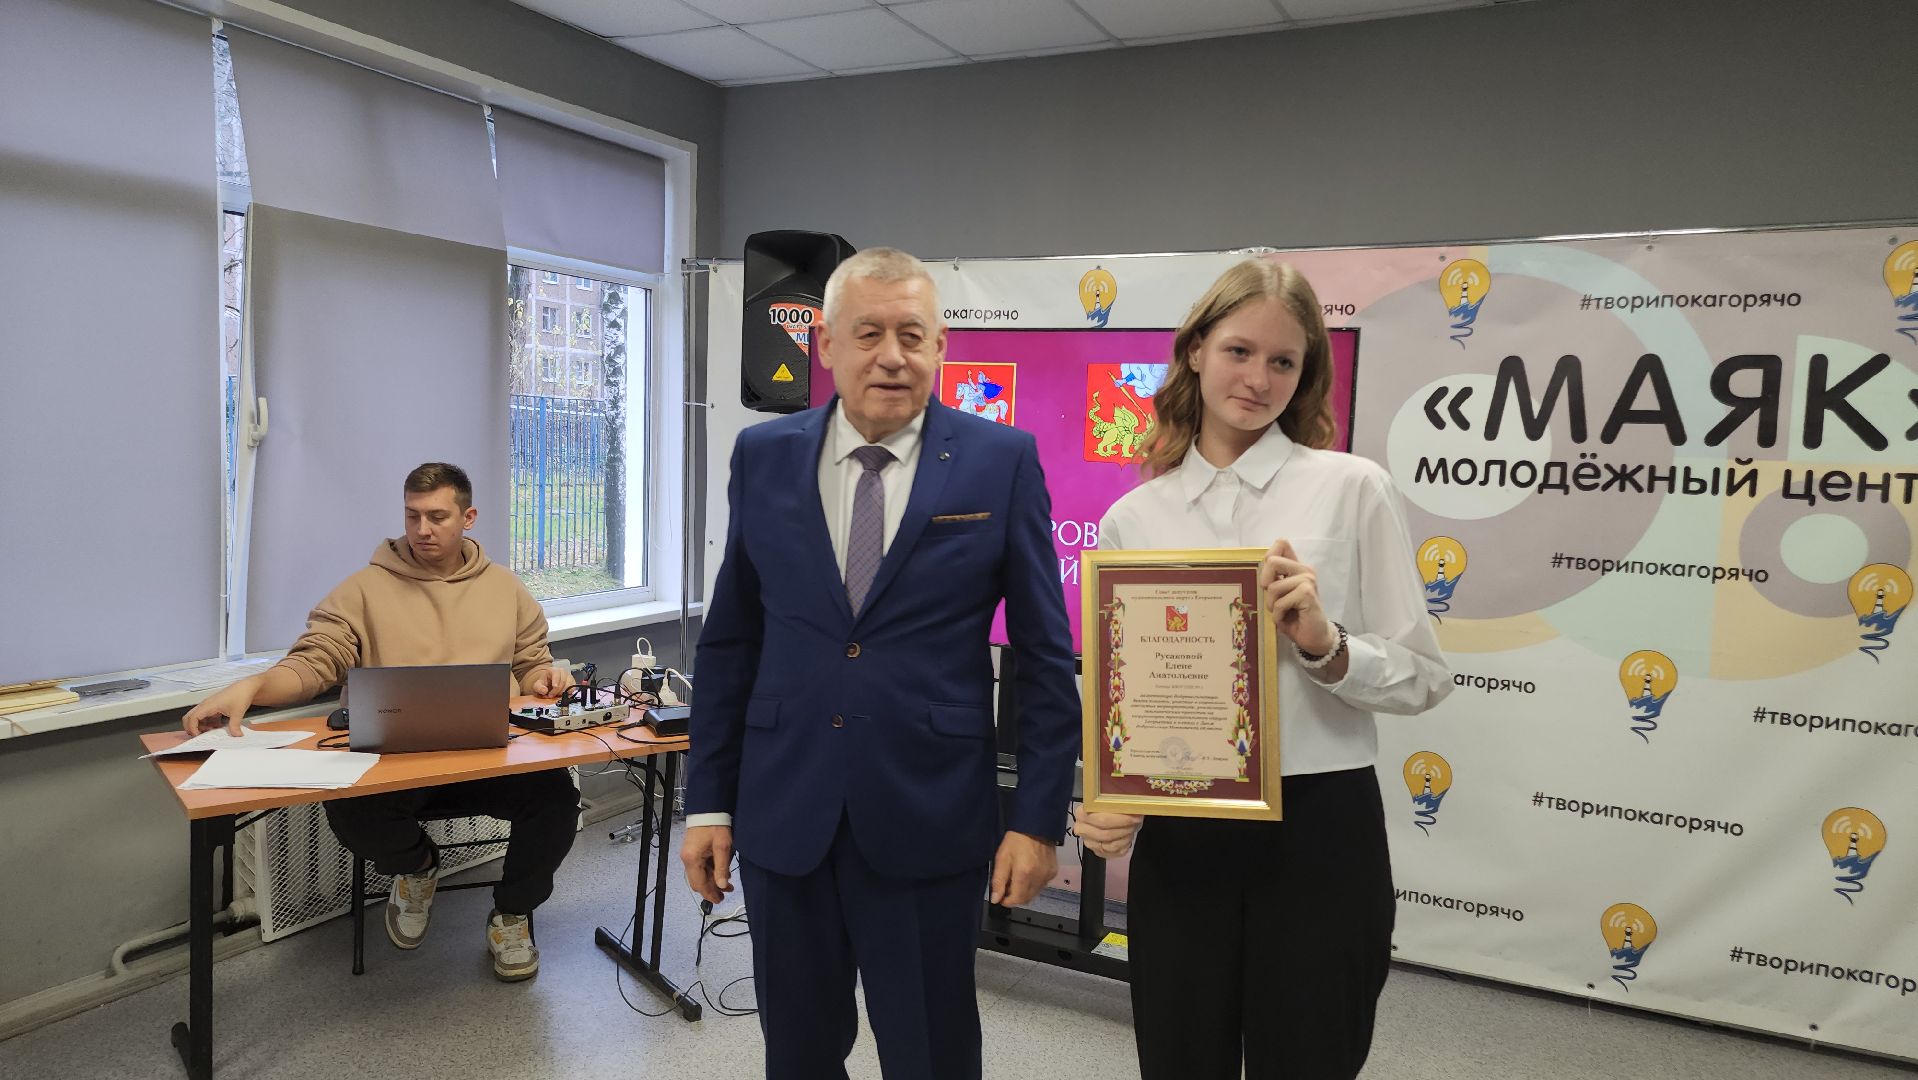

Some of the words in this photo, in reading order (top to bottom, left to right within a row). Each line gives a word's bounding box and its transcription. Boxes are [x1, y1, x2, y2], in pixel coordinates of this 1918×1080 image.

[769, 307, 814, 325] 1000
[1580, 292, 1802, 314] #творипокагорячо
[796, 332, 809, 342] M
[1424, 352, 1918, 452] «МАЯК
[1414, 452, 1759, 505] молодёжный
[1782, 468, 1918, 507] цент
[1550, 551, 1770, 585] #творипокагорячо
[1451, 673, 1537, 694] агорячо
[1532, 791, 1744, 837] #творипокагорячо
[1730, 946, 1918, 996] #творипокагор
